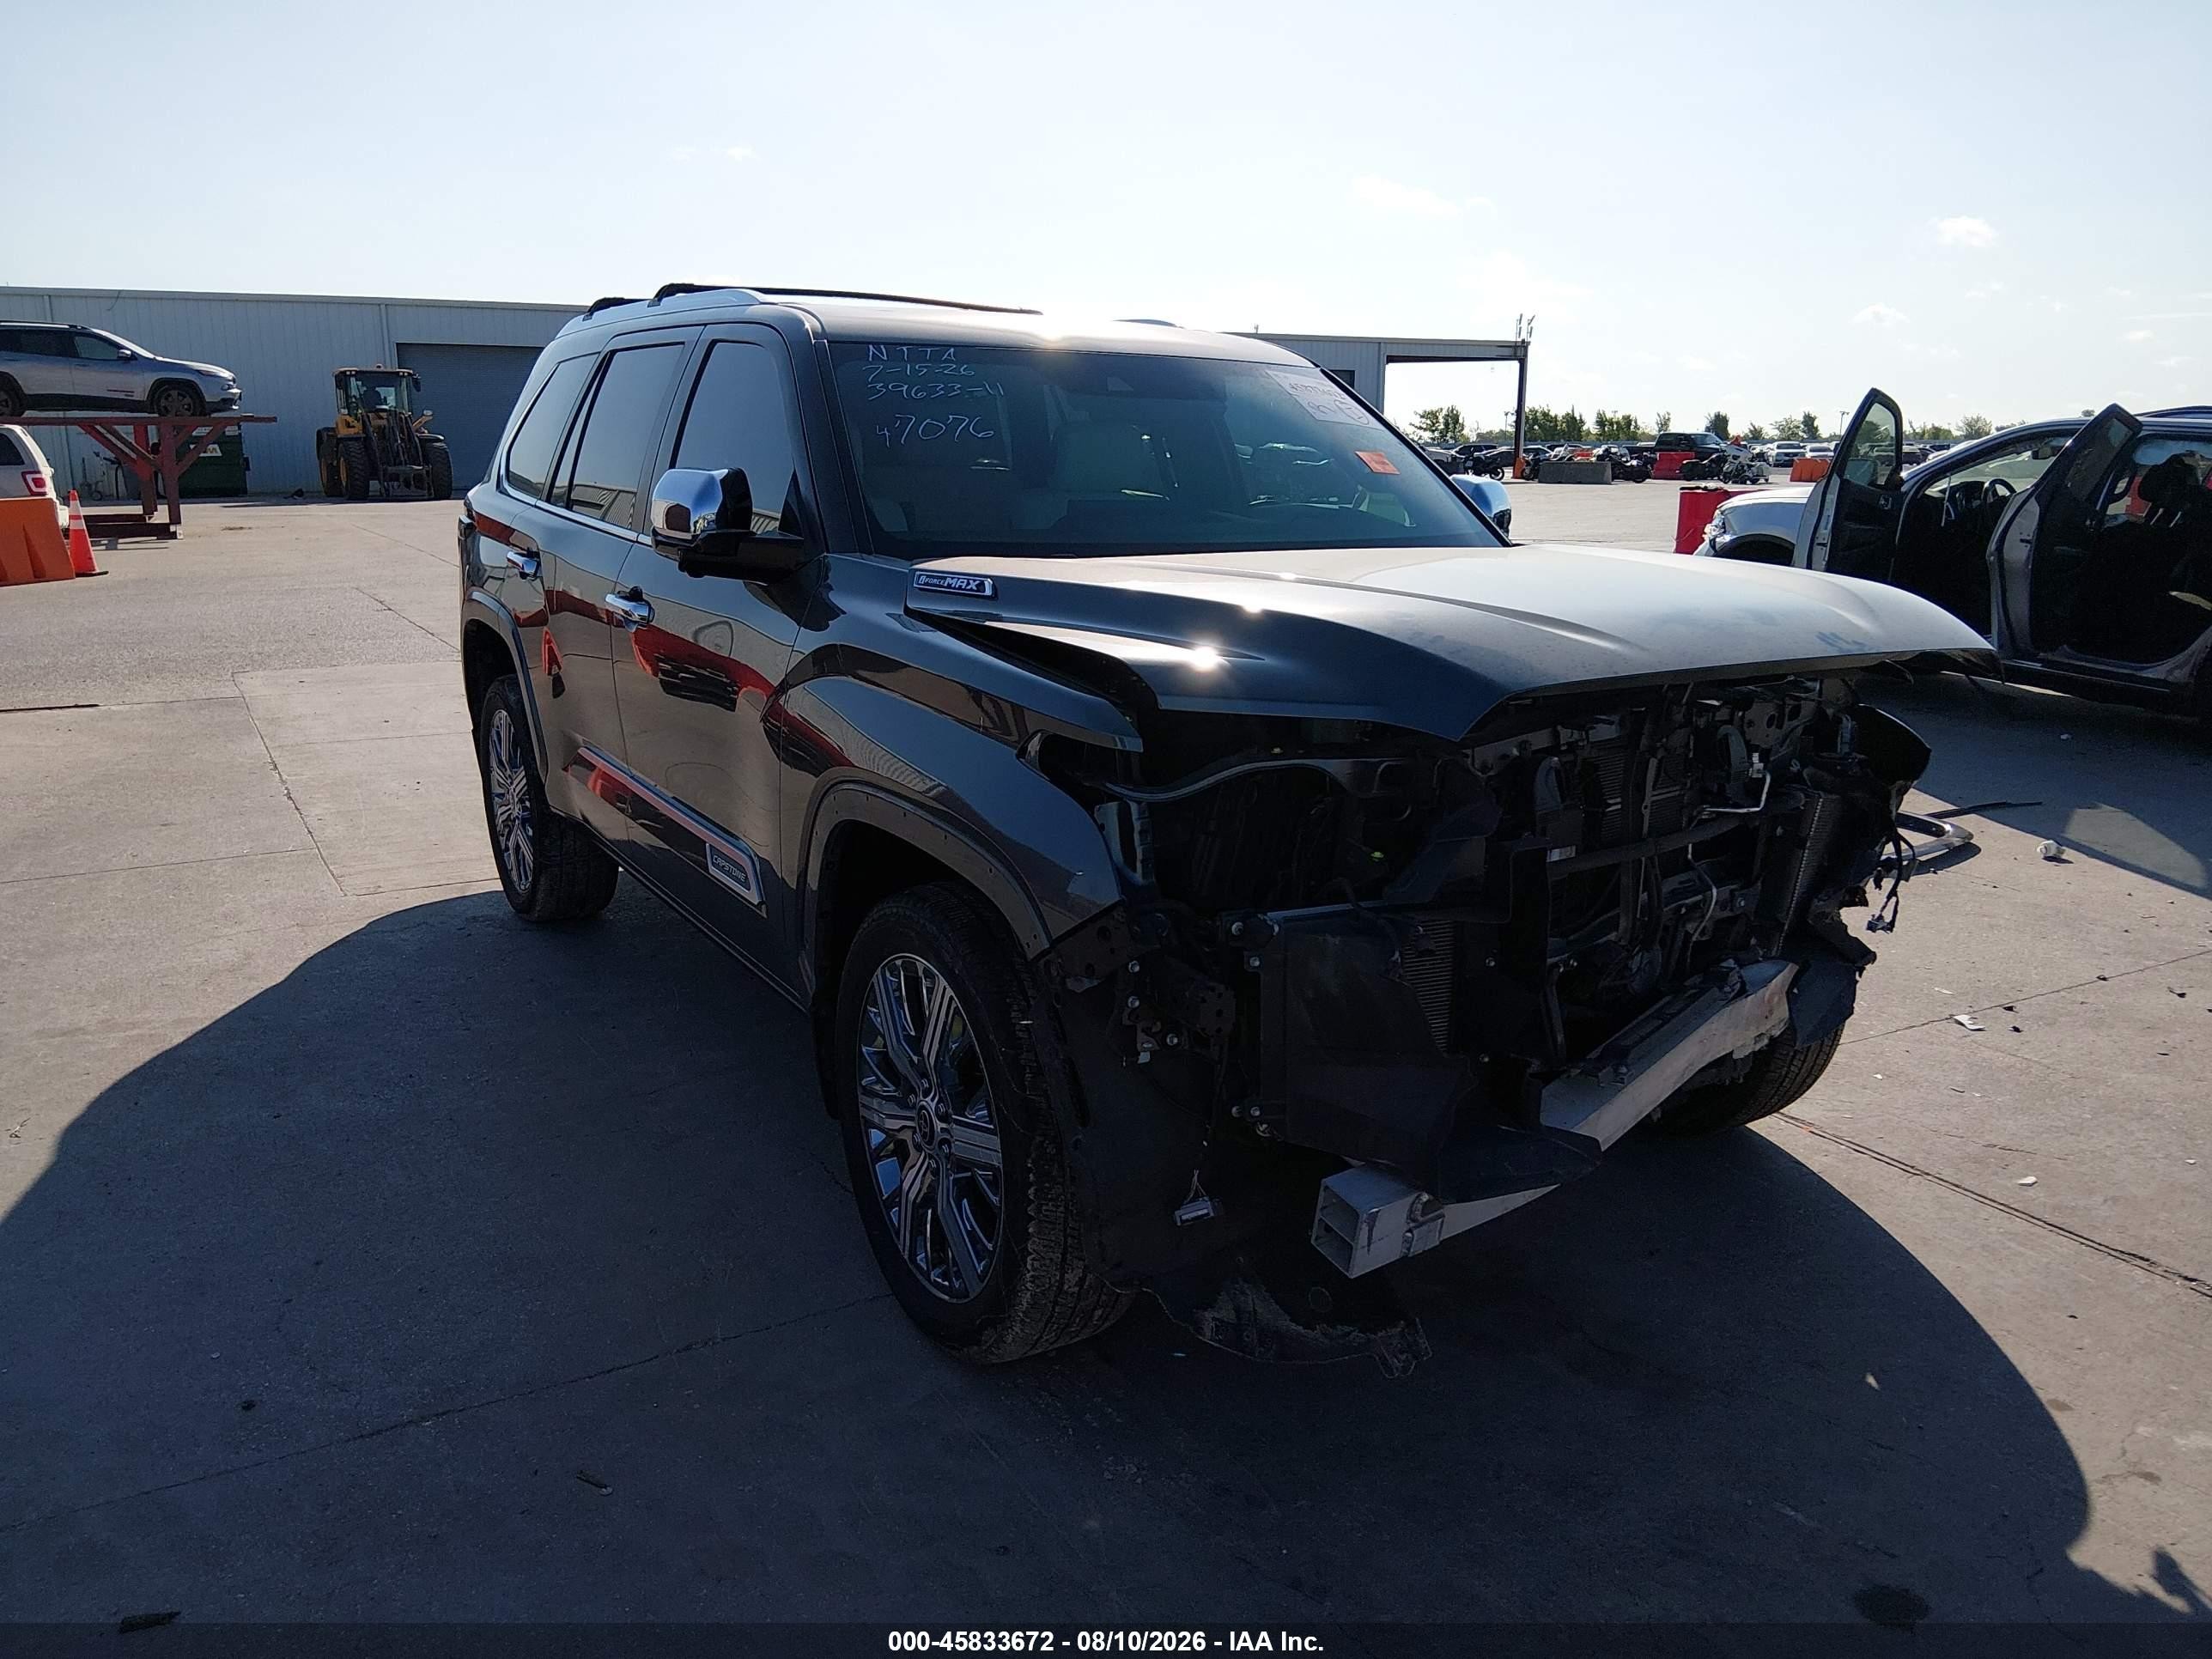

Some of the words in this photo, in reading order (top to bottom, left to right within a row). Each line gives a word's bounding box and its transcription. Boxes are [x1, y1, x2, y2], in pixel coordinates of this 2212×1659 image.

[867, 344, 956, 362] NTTA
[861, 364, 976, 383] 7-15-26
[866, 382, 1005, 402] 39633-11
[713, 855, 746, 882] CAPSTONE
